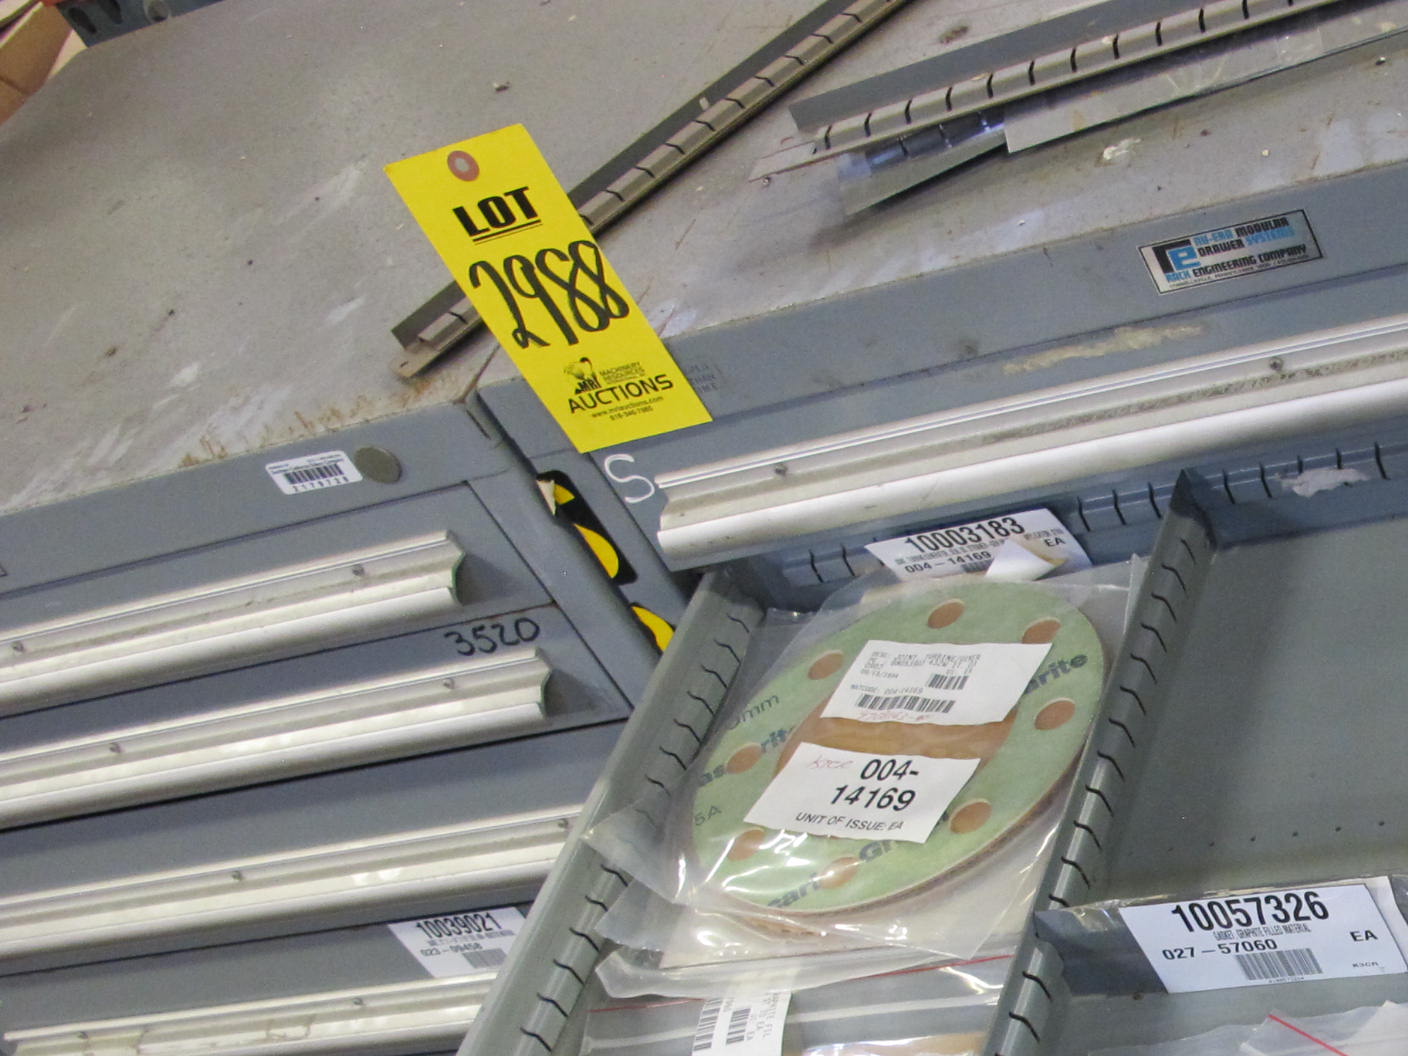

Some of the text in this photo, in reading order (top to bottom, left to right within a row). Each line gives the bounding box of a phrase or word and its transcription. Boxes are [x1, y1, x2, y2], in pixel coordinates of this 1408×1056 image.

[452, 186, 539, 237] LOT
[1193, 255, 1257, 278] ENGINEERING
[468, 239, 630, 349] 2988
[568, 374, 674, 414] AUCTIONS
[604, 454, 655, 503] S
[904, 517, 1025, 553] 10003183
[1045, 536, 1065, 548] EA
[860, 759, 920, 781] 004-
[831, 785, 916, 812] 14169
[795, 812, 828, 823] UNIT
[828, 816, 845, 825] OF
[888, 821, 904, 830] EA
[1172, 890, 1329, 933] 10057326
[1350, 929, 1378, 942] EA
